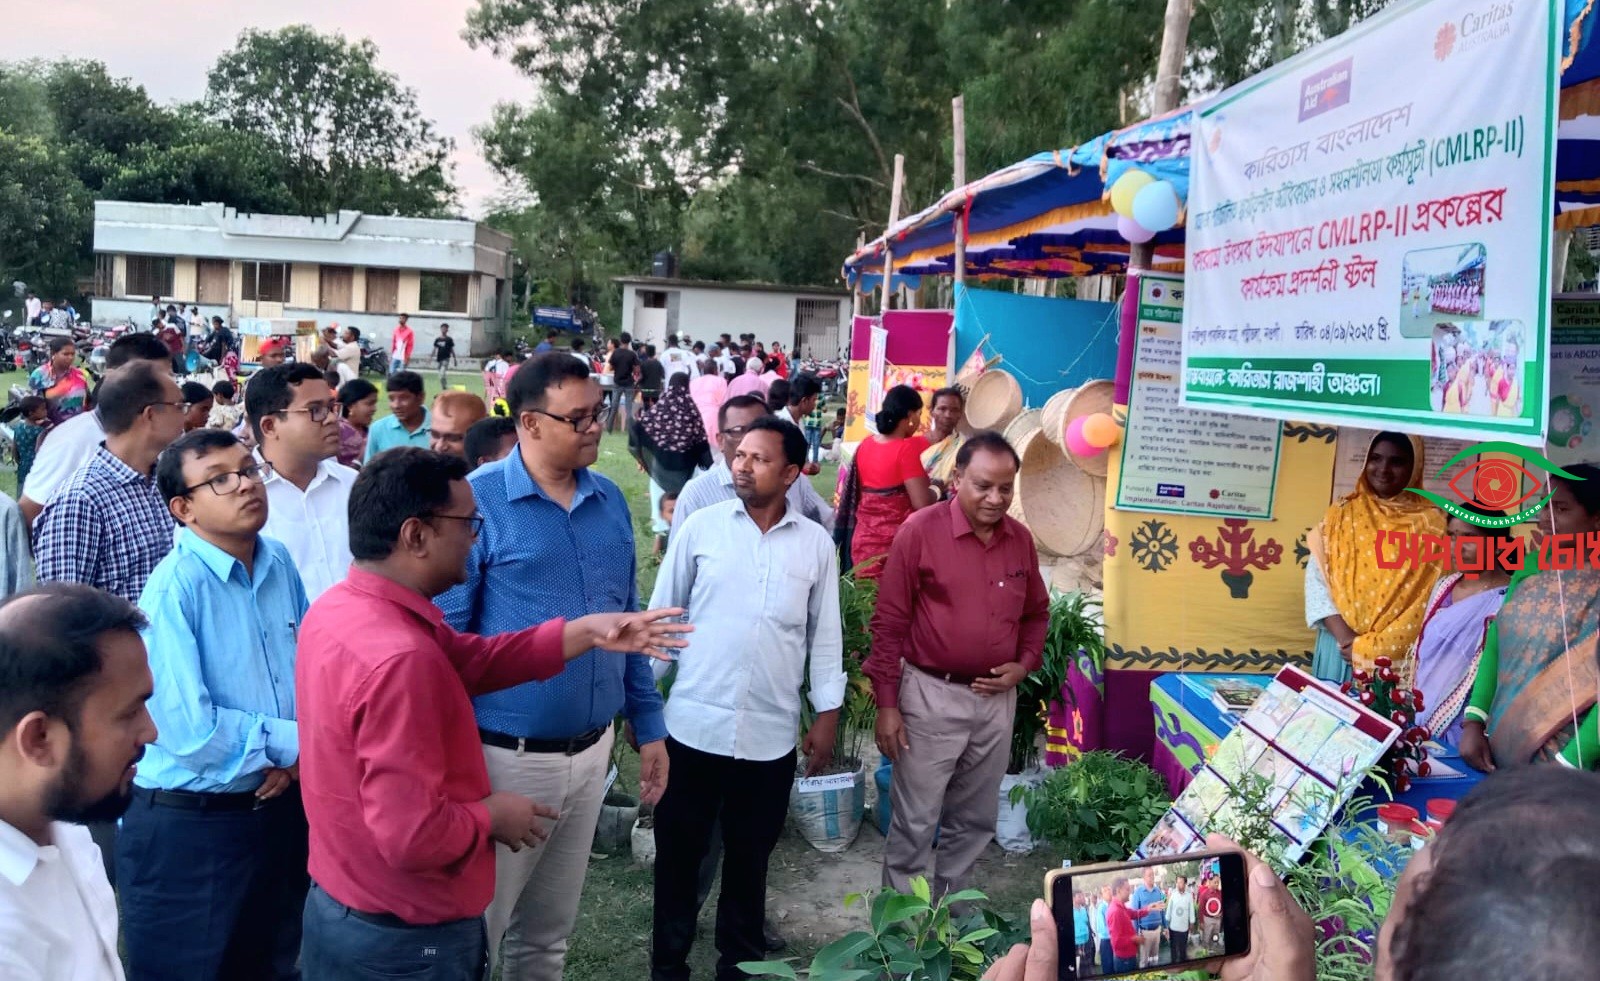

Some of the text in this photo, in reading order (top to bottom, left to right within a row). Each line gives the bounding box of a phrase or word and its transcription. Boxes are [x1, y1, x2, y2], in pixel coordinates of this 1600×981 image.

[1460, 0, 1514, 38] Caritas
[1303, 93, 1319, 111] Aid
[1304, 70, 1348, 97] Australian
[1244, 102, 1414, 180] কারিতাস বাংলাদেশ
[1329, 156, 1384, 195] সহনশীলতা
[1429, 115, 1525, 178] (CMLRP-II)
[1255, 226, 1315, 259] উদযাপনে
[1317, 203, 1409, 251] CMLRP-II
[1412, 186, 1508, 232] প্রকল্পের
[1241, 269, 1287, 300] কার্যক্রম
[1287, 259, 1341, 296] প্রদর্শনী
[1319, 320, 1375, 346] ০৪/০৯/২০২৫
[1227, 362, 1272, 390] কারিতাস
[1273, 362, 1325, 394] রাজশাহী
[1327, 371, 1381, 397] অঞ্চল।
